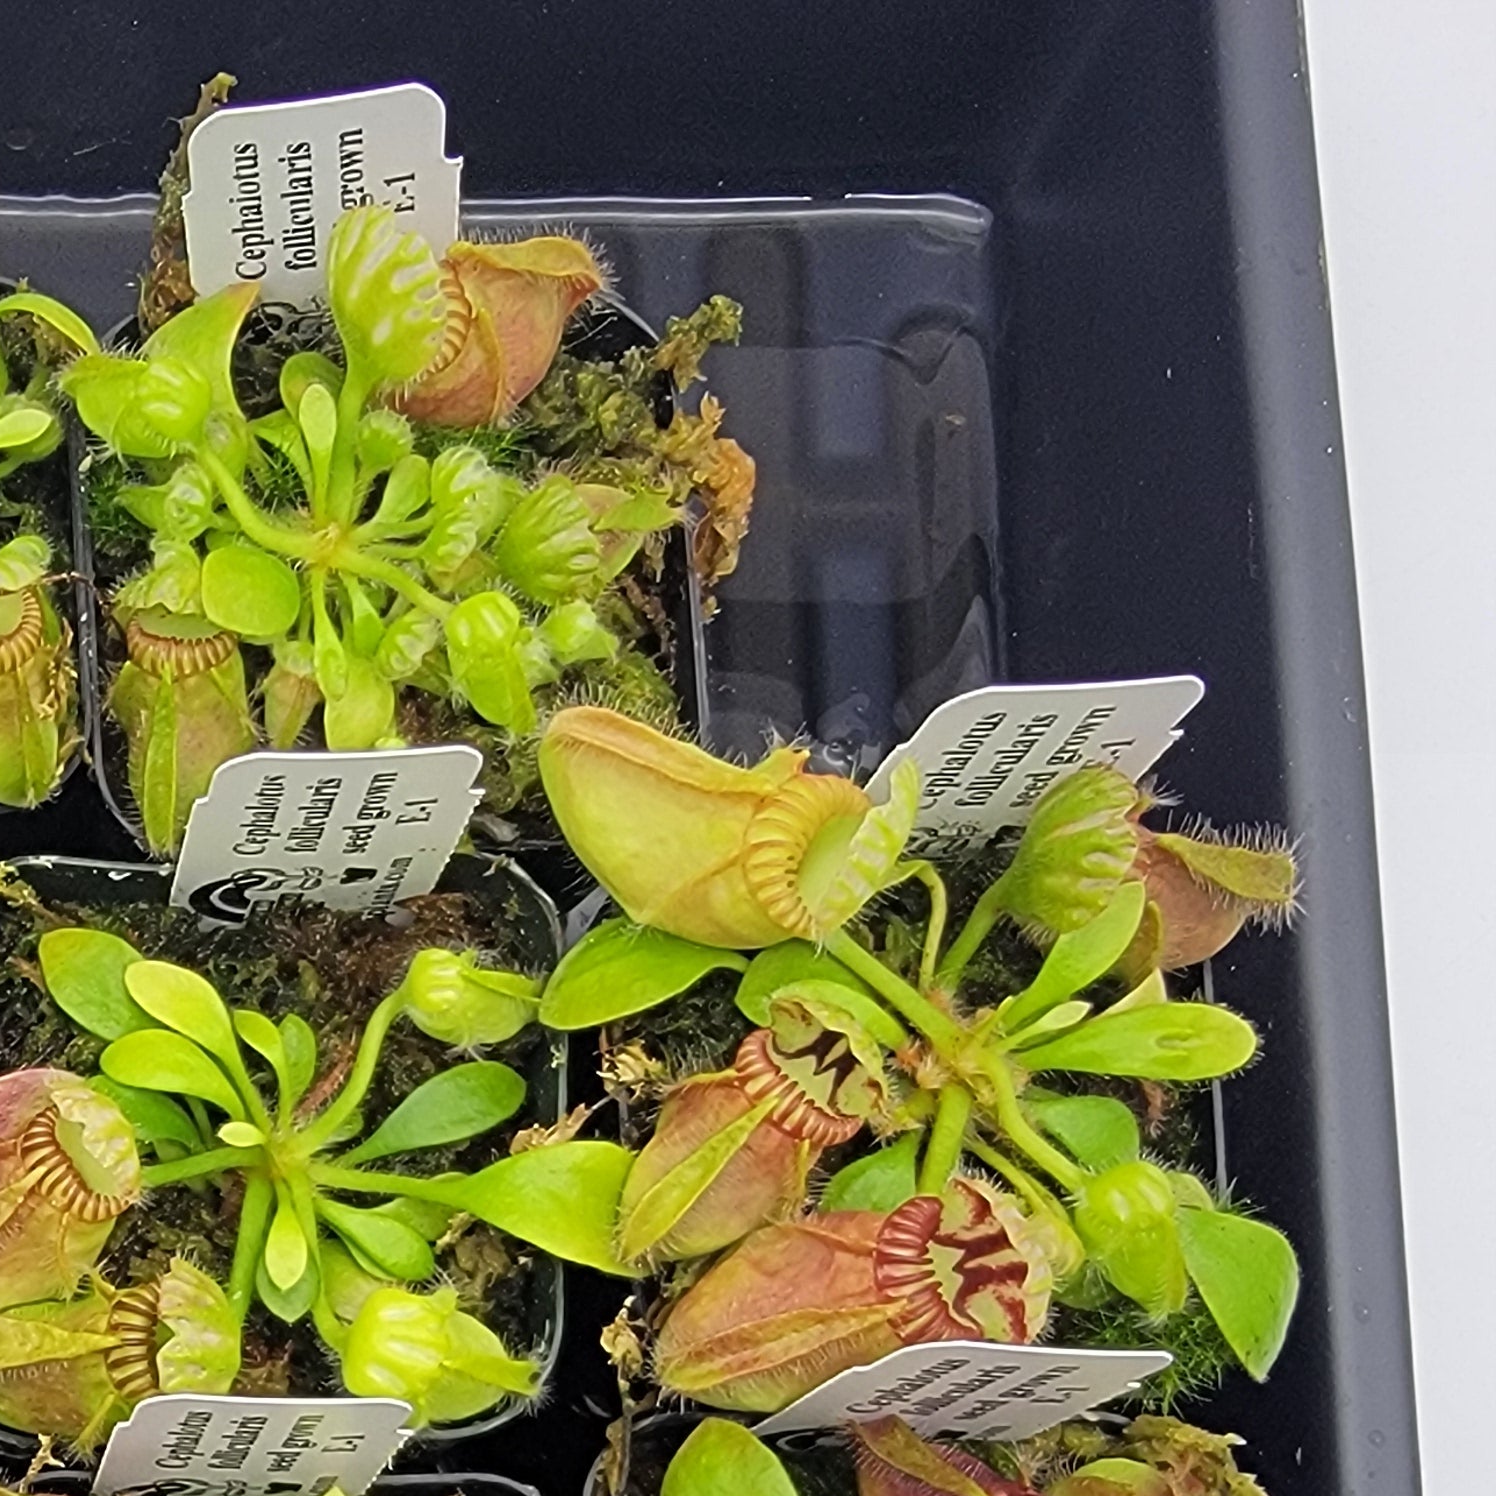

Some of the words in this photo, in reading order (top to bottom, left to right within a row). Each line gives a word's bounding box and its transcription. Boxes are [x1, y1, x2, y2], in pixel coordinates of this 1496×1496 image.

[279, 142, 317, 270] follicularis
[233, 775, 286, 855] Cephalotus
[284, 778, 343, 851] follicularis
[357, 773, 398, 819] grown
[396, 798, 438, 825] E-1
[342, 825, 375, 854] seed
